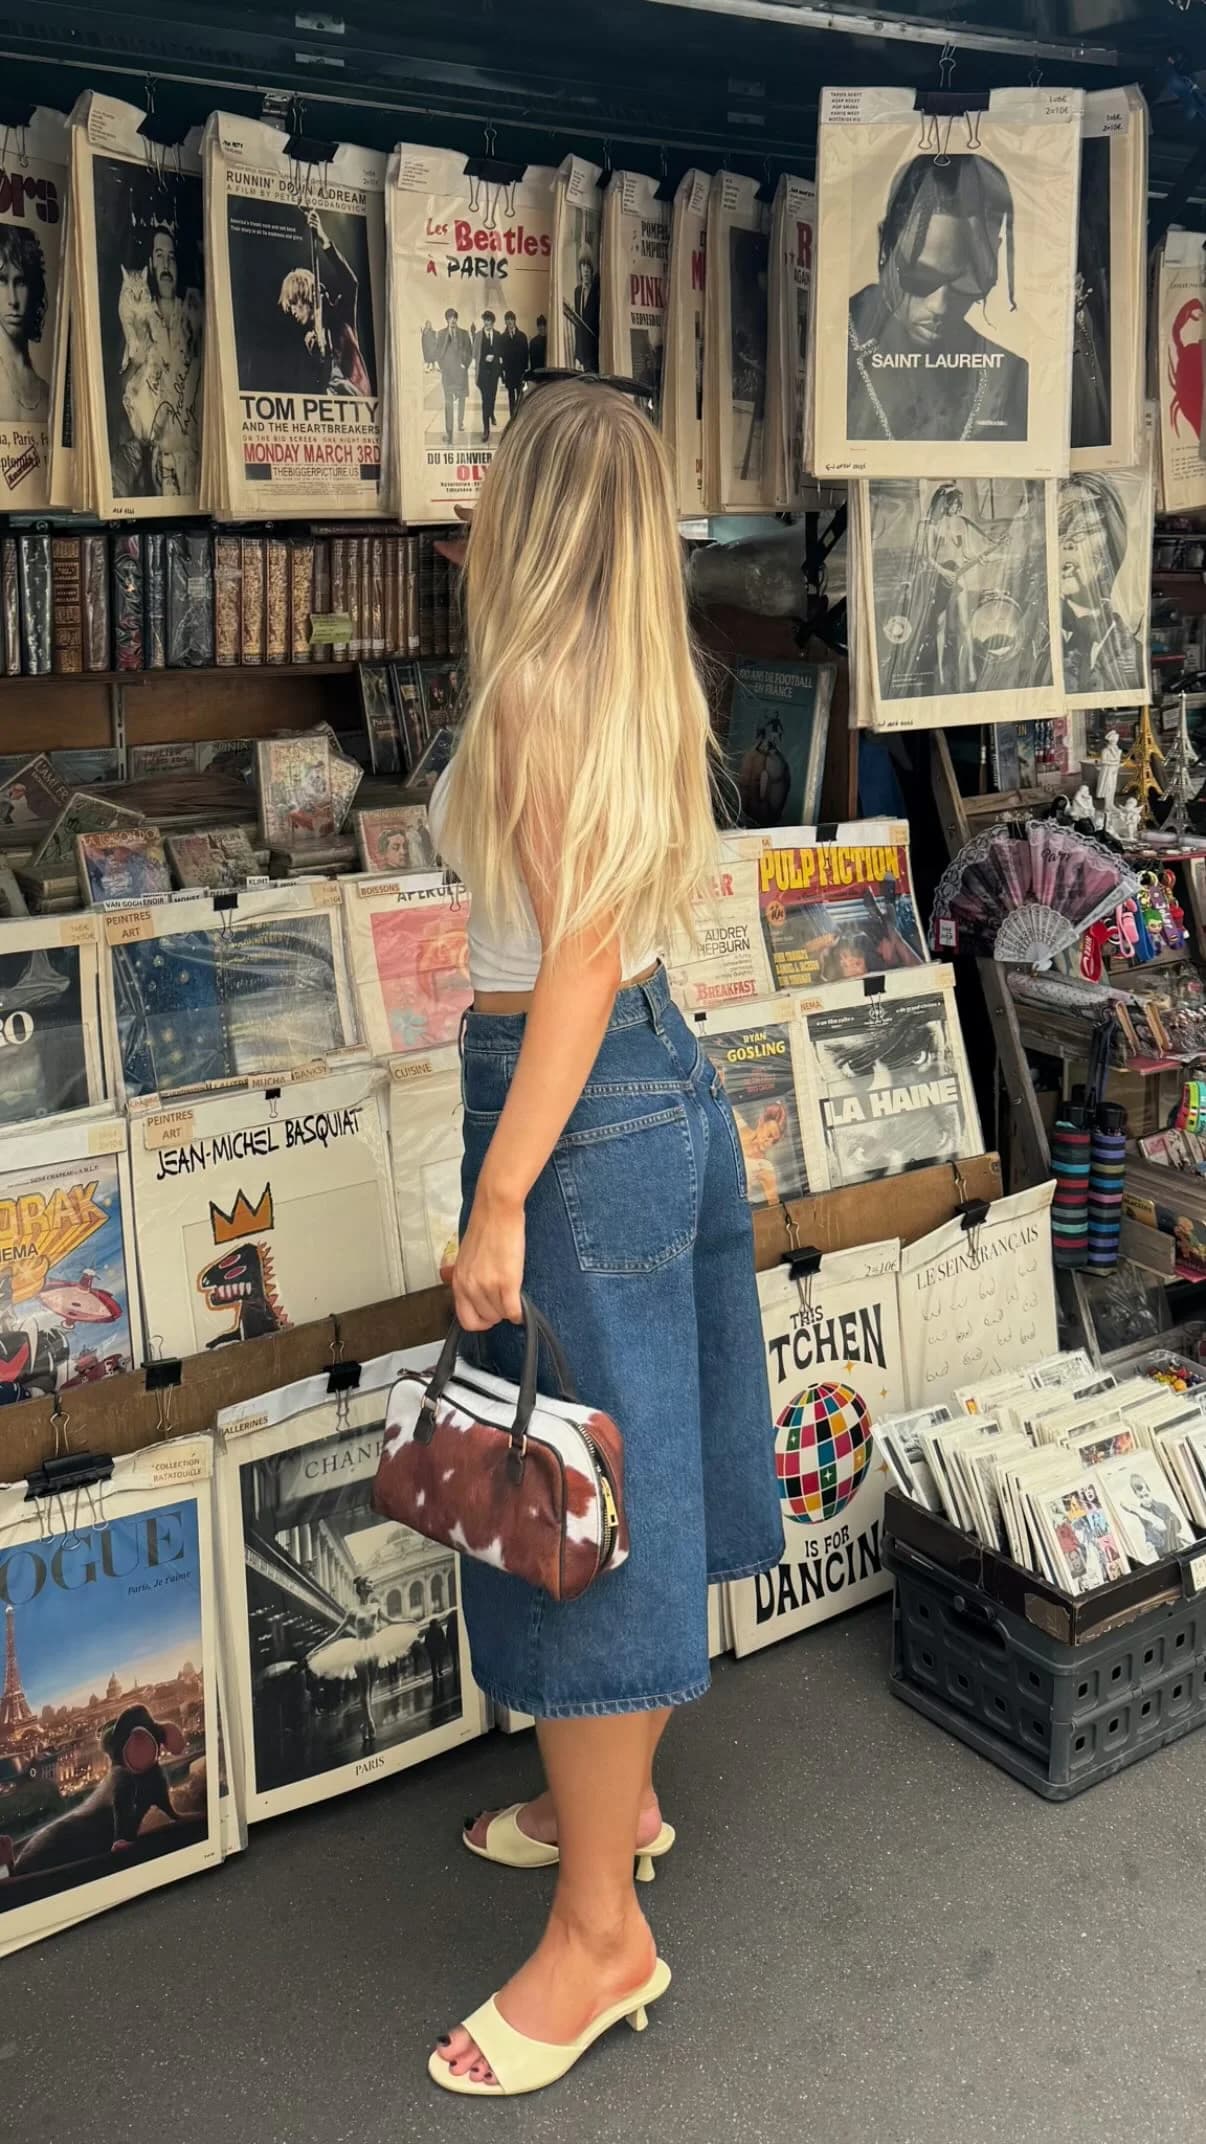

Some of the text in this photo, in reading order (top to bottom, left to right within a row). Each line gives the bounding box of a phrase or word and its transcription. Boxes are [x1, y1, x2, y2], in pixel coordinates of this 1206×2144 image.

[226, 171, 275, 190] RUNNIN'
[329, 190, 367, 206] DREAM
[426, 218, 551, 257] Les Beatles
[446, 255, 509, 280] PARIS
[871, 353, 1005, 369] SAINT LAURENT
[239, 396, 380, 424] TOM PETTY
[242, 421, 380, 435] AND THE HEARTBREAKERS
[243, 443, 381, 463] MONDAY MARCH 3RD
[427, 452, 493, 465] DU 16 JANVIER
[760, 846, 899, 893] PULP FICTION
[360, 883, 401, 897] BOISSONS
[105, 900, 121, 908] VAN
[105, 911, 151, 925] PEINTRES
[121, 926, 141, 938] ART
[704, 925, 749, 942] AUDREY
[694, 980, 757, 1000] BREAKFAST
[743, 1031, 767, 1044] RYAN
[727, 1040, 786, 1063] GOSLING
[394, 1063, 433, 1079] CUISINE
[251, 1076, 286, 1088] MUCHA
[823, 1077, 959, 1126] LA HAINE
[146, 1109, 194, 1127] PEINTRES
[156, 1126, 280, 1180] JEAN-MICHEL
[285, 1107, 363, 1148] BASQUIAT
[161, 1127, 182, 1140] ART
[916, 1269, 936, 1291] LE
[937, 1253, 972, 1282] SEIN
[789, 1305, 824, 1330] THIS
[769, 1303, 887, 1384] TCHEN
[154, 1458, 201, 1471] COLLECTION
[804, 1524, 850, 1558] IS FOR
[354, 1755, 386, 1777] PARIS
